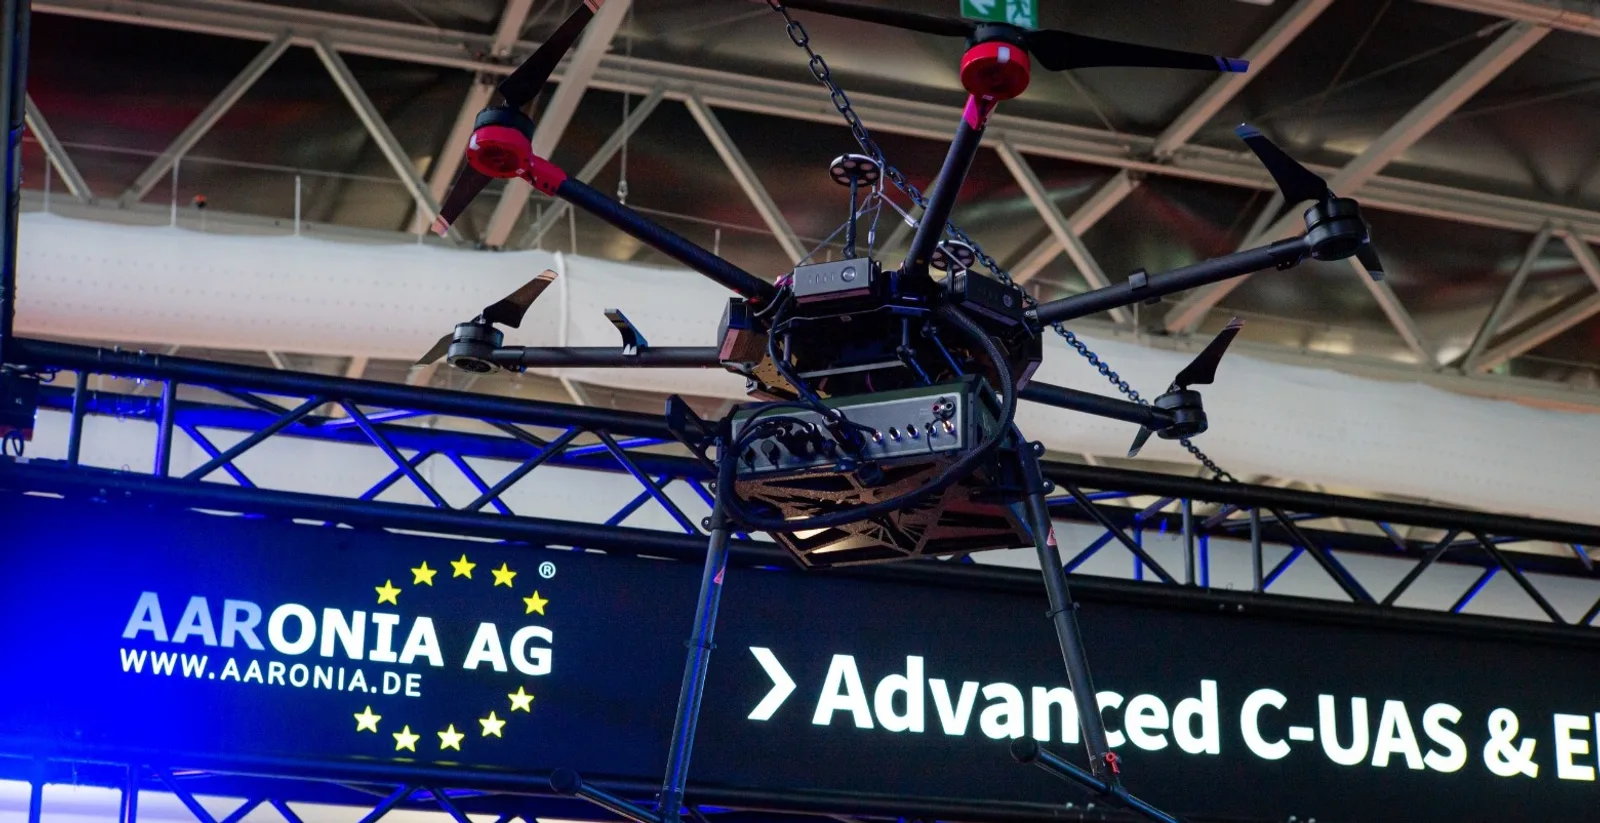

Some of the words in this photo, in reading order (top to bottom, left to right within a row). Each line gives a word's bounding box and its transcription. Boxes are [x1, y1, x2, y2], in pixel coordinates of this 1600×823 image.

[120, 648, 421, 697] WWW.AARONIA.DE
[122, 591, 444, 666] AARONIA
[463, 622, 553, 676] AG
[812, 653, 1219, 755] Advanced
[1240, 687, 1468, 774] C-UAS
[1483, 706, 1538, 778] &
[1554, 712, 1600, 782] E
